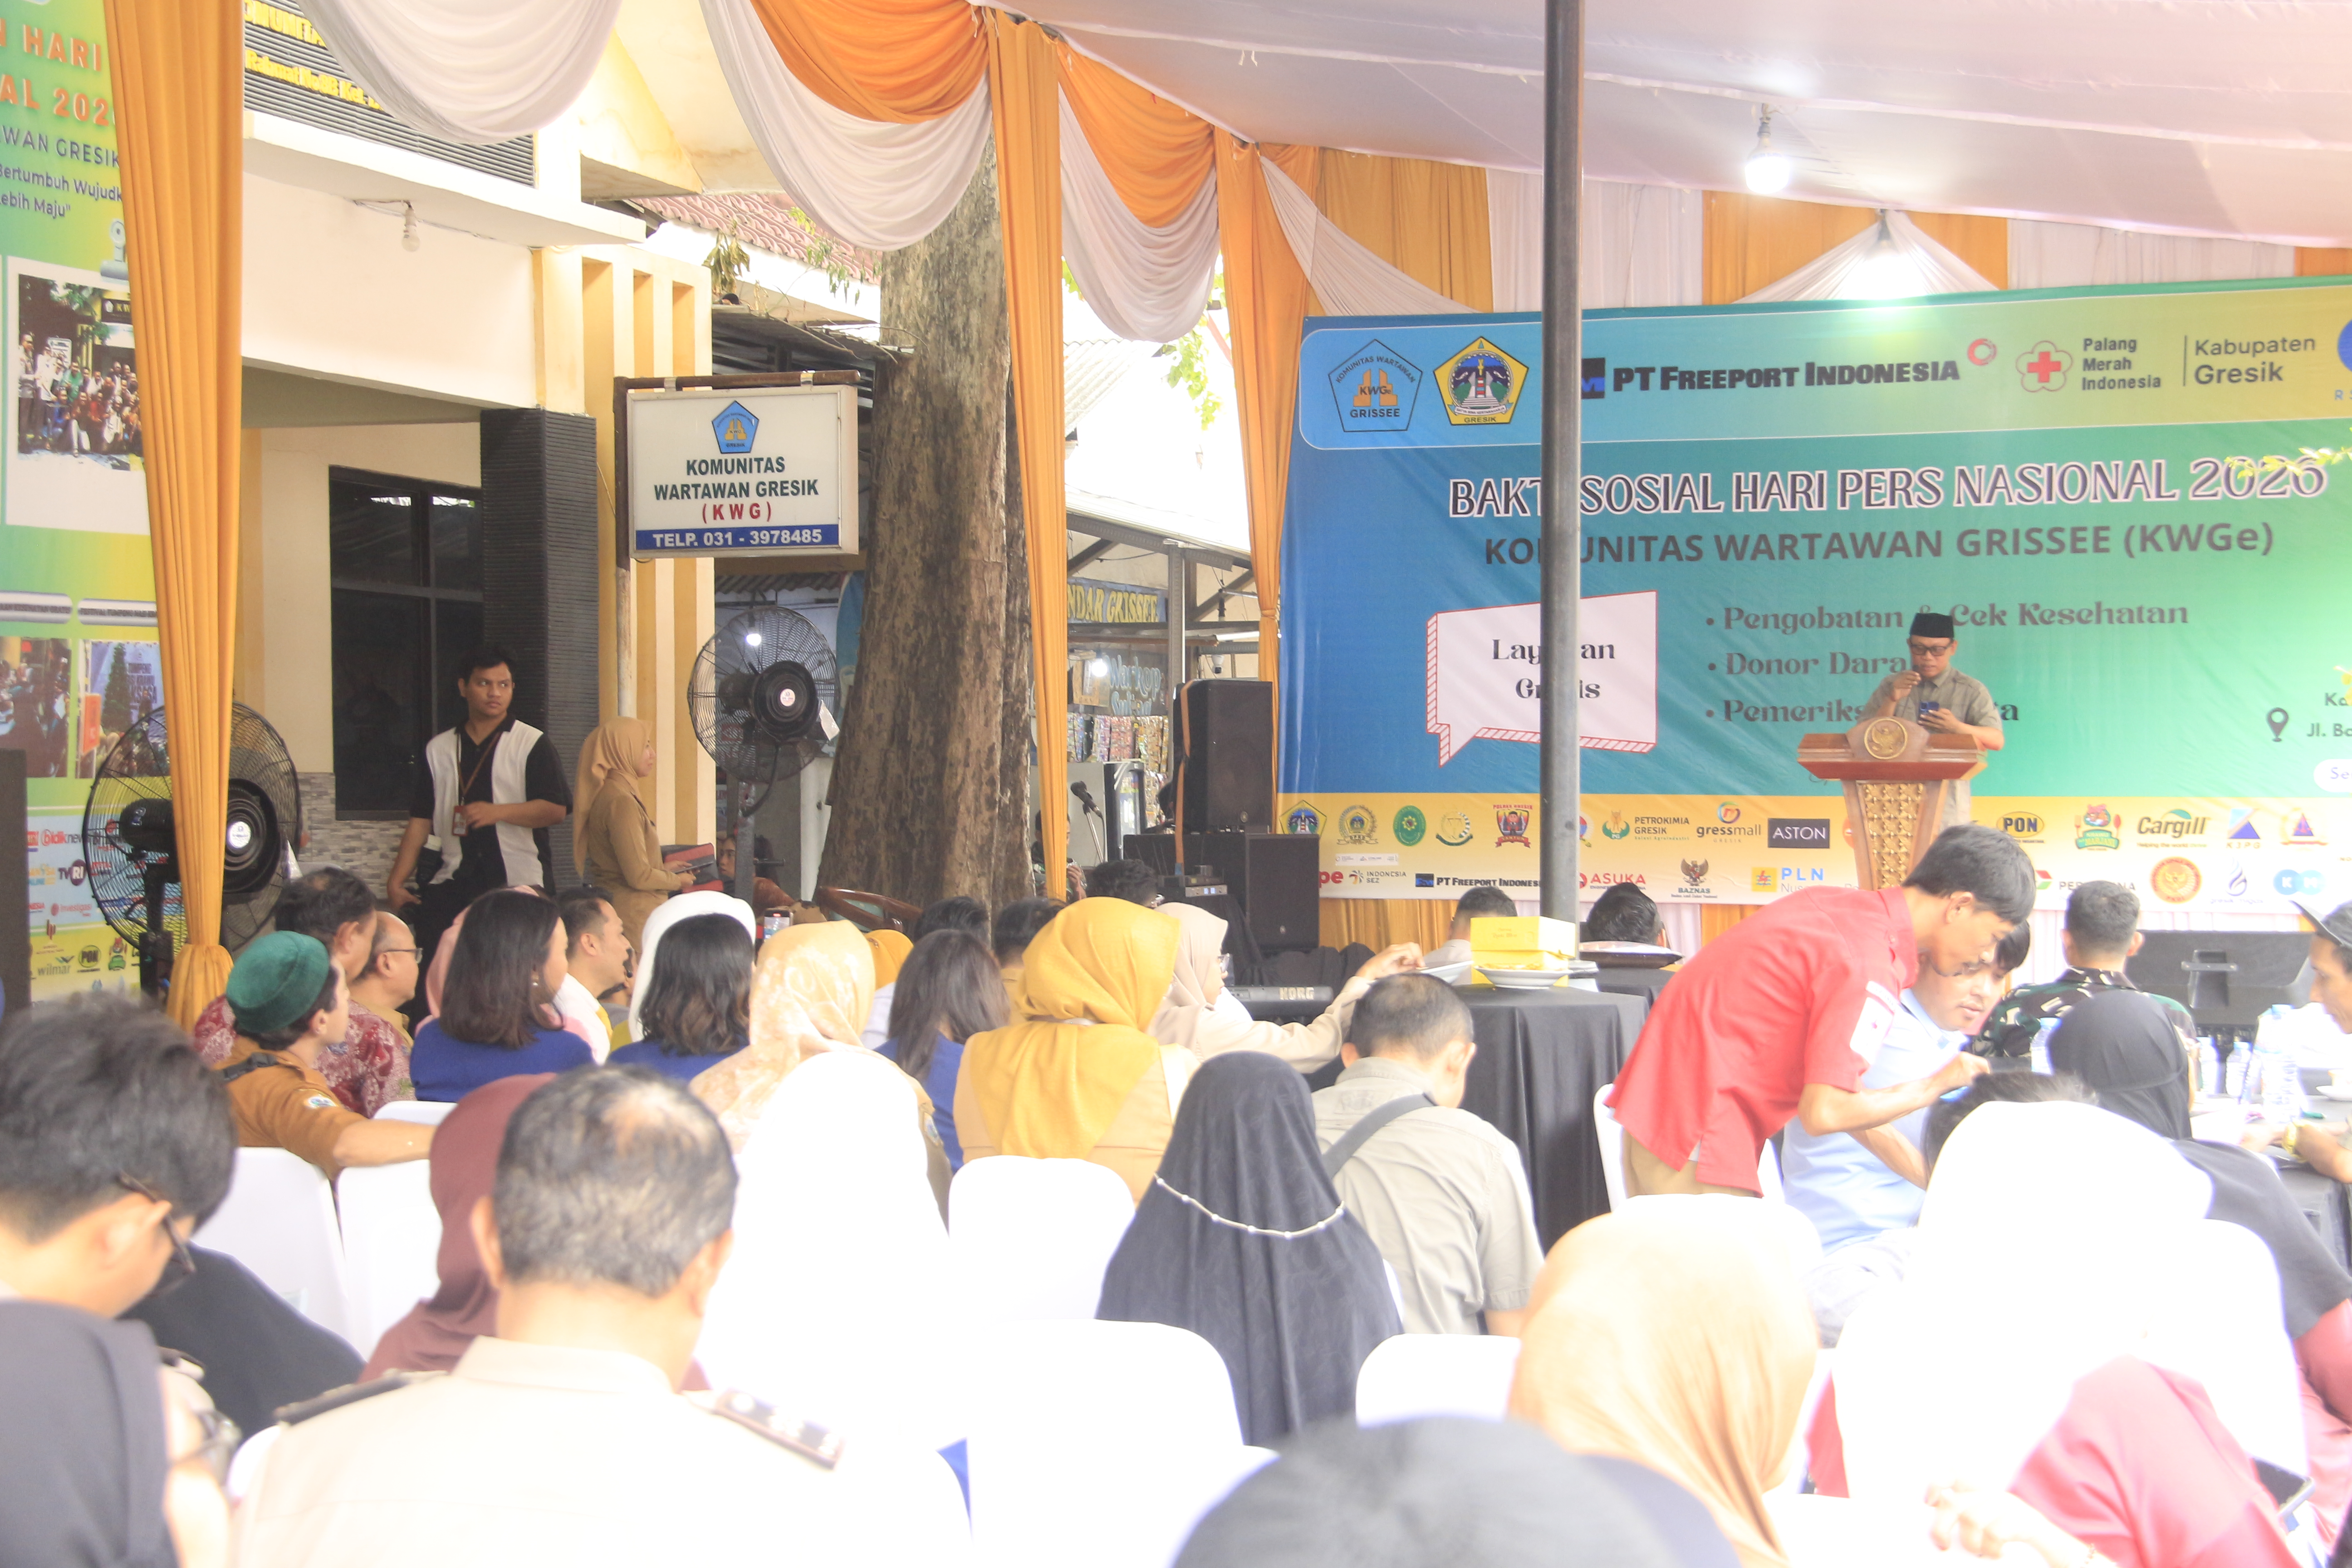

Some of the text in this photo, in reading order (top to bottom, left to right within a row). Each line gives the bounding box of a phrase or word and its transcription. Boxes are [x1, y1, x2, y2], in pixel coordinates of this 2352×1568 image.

[23, 24, 102, 72] HARI
[245, 49, 300, 86] Rahmat
[53, 88, 117, 127] 202
[56, 138, 119, 168] GRESIK
[34, 196, 71, 219] Maju"
[2082, 338, 2138, 352] Palang
[2195, 337, 2316, 358] Kabupaten
[1336, 356, 1416, 384] KOMUNITAS WARTAWAN
[2082, 358, 2132, 372] Merah
[2194, 362, 2283, 385] Gresik
[1613, 360, 1960, 392] PT FREEPORT INDONESIA
[2082, 374, 2162, 391] Indonesia
[1350, 408, 1401, 418] GRISSEE
[686, 456, 786, 476] KOMUNITAS
[654, 479, 819, 500] WARTAWAN GRESIK
[1580, 472, 1725, 516] SOSIAL
[1732, 470, 1828, 512] HARI
[1837, 466, 1944, 511] PERS
[1953, 459, 2180, 507] NASIONAL
[2189, 455, 2329, 501] 2026
[653, 533, 698, 548] TELP.
[703, 532, 733, 546] 031
[749, 529, 823, 544] 3978485
[1485, 522, 2274, 564] KOUNITAS WARTAWAN GRISSEE (KWGe)
[1724, 600, 2189, 635] Pengobatan Cek Kesehatan
[1492, 639, 1616, 665] Layan
[1726, 652, 1819, 676] Donor
[1515, 678, 1601, 699] Gris
[2307, 723, 2327, 737] Jl.
[2330, 767, 2352, 779] Se
[1634, 817, 1690, 825] PETROKIMIA
[1696, 824, 1761, 838] gressmall
[2003, 818, 2037, 832] PON
[2137, 816, 2206, 839] Cargill
[1772, 827, 1826, 840] ASTON
[1436, 877, 1450, 885] PT
[1590, 872, 1646, 885] ASUKA
[1781, 867, 1824, 881] PLN
[38, 963, 72, 975] wilmar
[1279, 987, 1314, 1000] KORG
